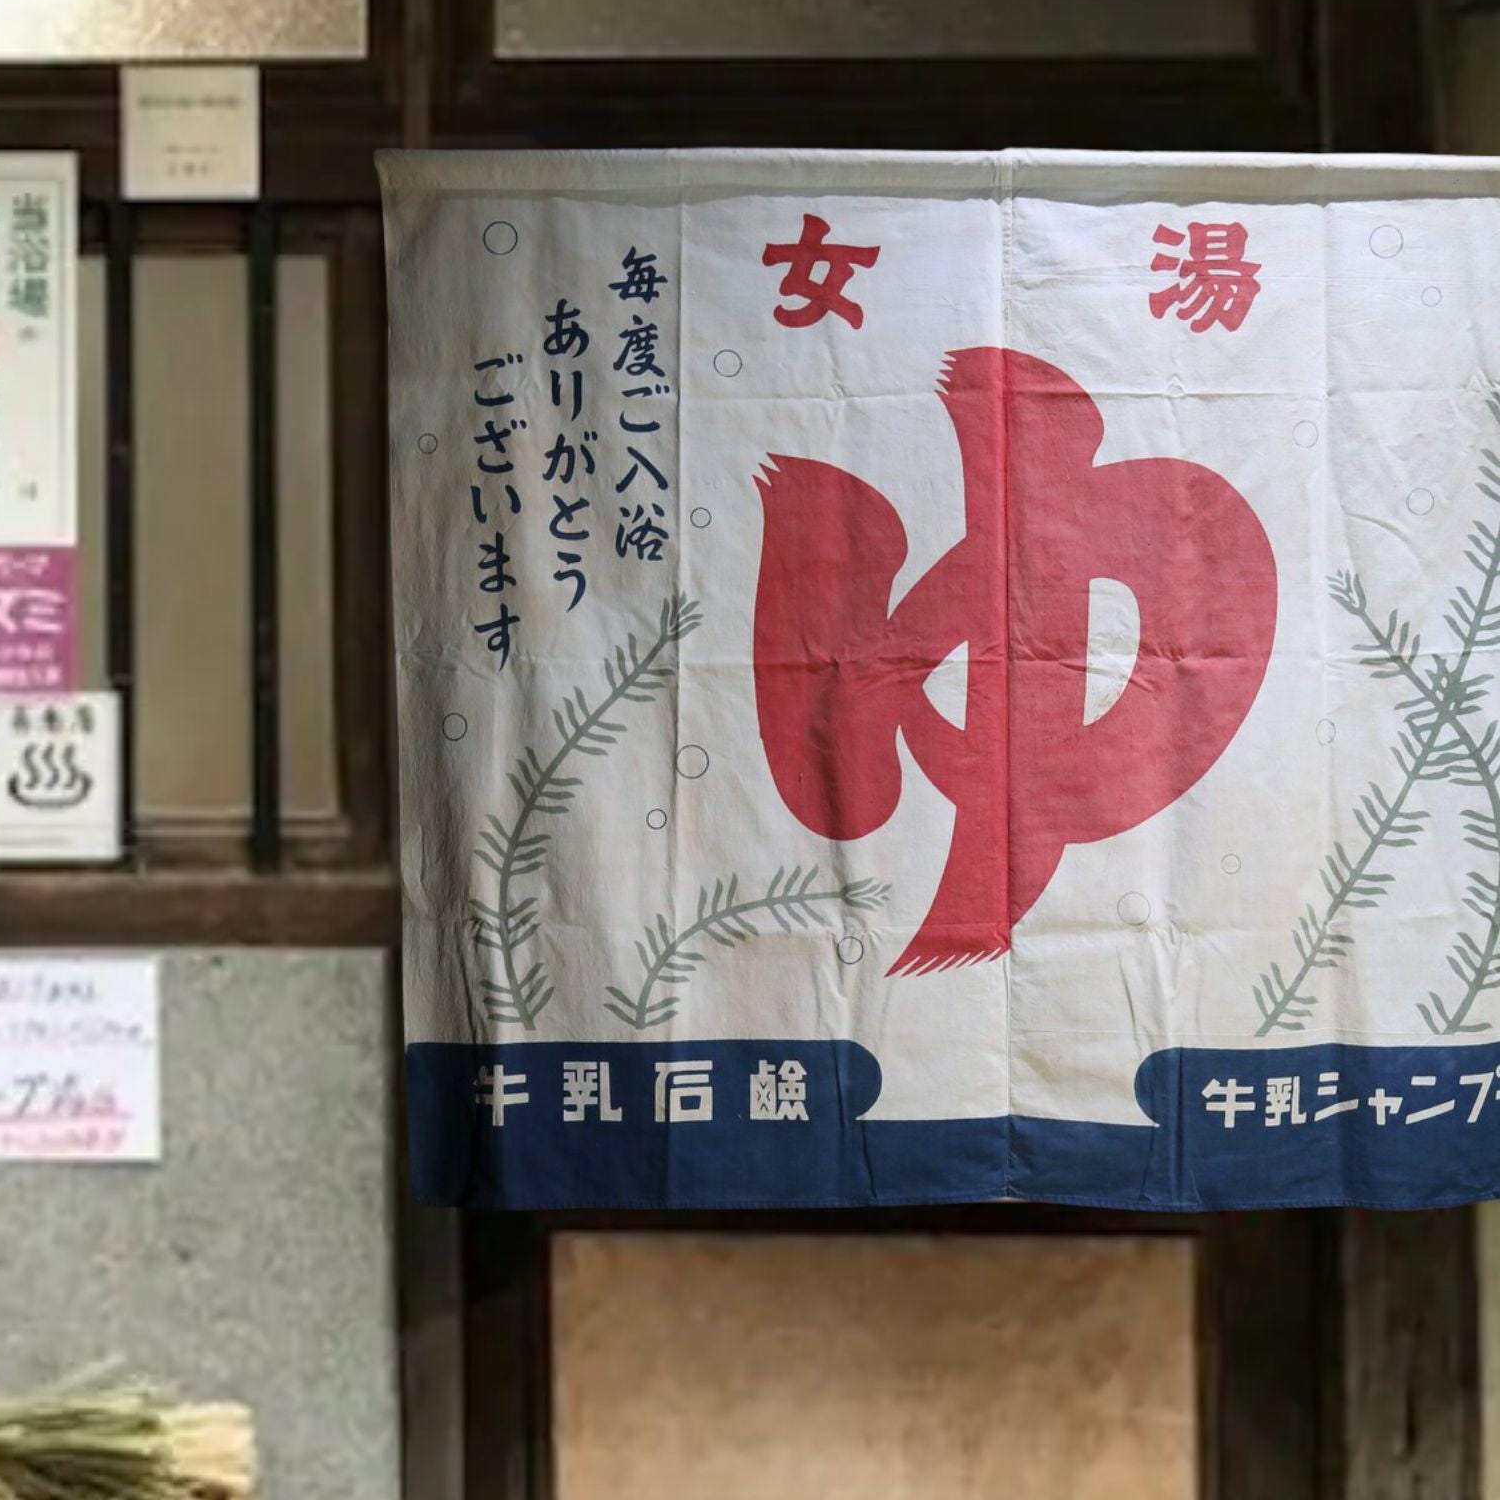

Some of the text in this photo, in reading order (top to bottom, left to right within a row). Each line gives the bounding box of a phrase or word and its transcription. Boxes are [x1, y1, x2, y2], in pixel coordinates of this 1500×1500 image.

[608, 245, 670, 562] 毎度ご入浴
[762, 213, 1262, 334] 女 湯
[470, 352, 527, 672] ございます
[542, 298, 598, 613] ありがとう
[751, 345, 1279, 978] ゆ
[1201, 1064, 1500, 1129] 牛乳シャンプ
